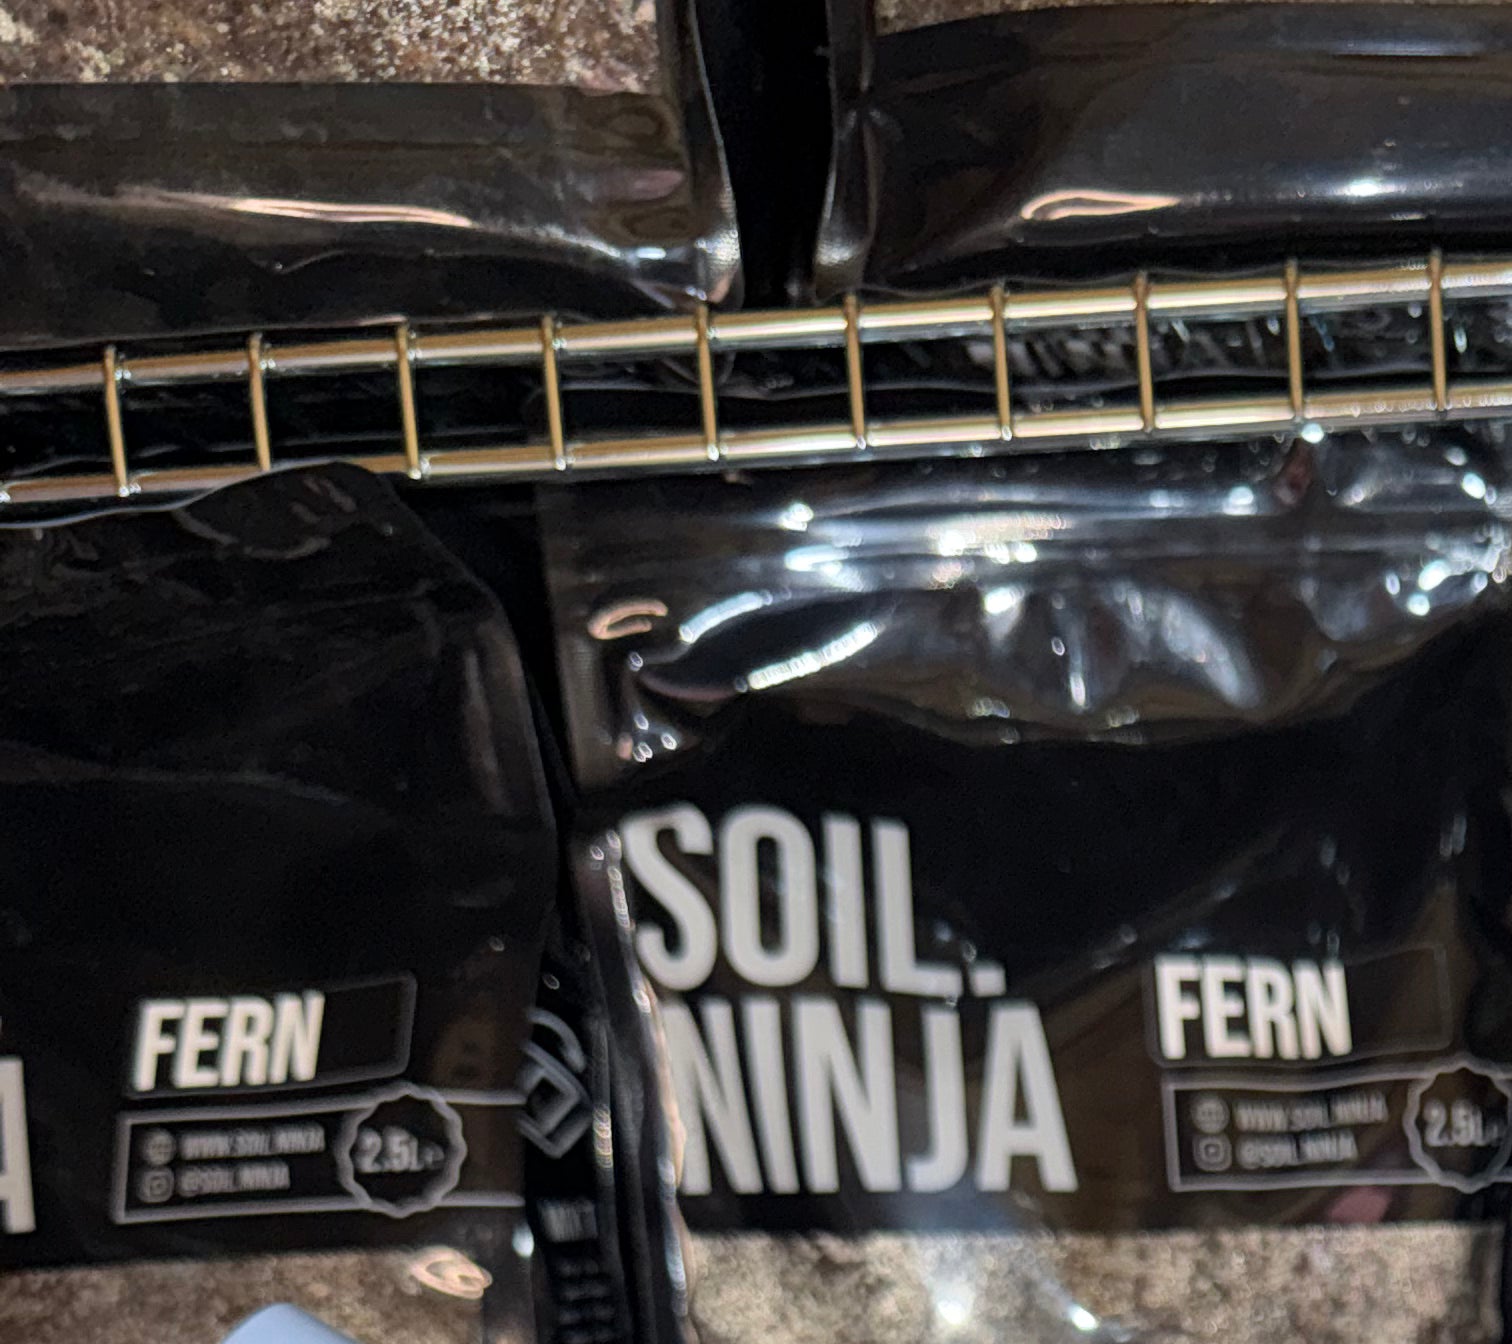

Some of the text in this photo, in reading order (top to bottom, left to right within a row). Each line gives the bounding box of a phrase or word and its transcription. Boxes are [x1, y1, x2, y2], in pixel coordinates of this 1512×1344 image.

[619, 804, 1006, 997] SOIL.
[135, 990, 325, 1092] FERN
[1155, 954, 1353, 1061] FERN
[656, 998, 1079, 1196] NINJA
